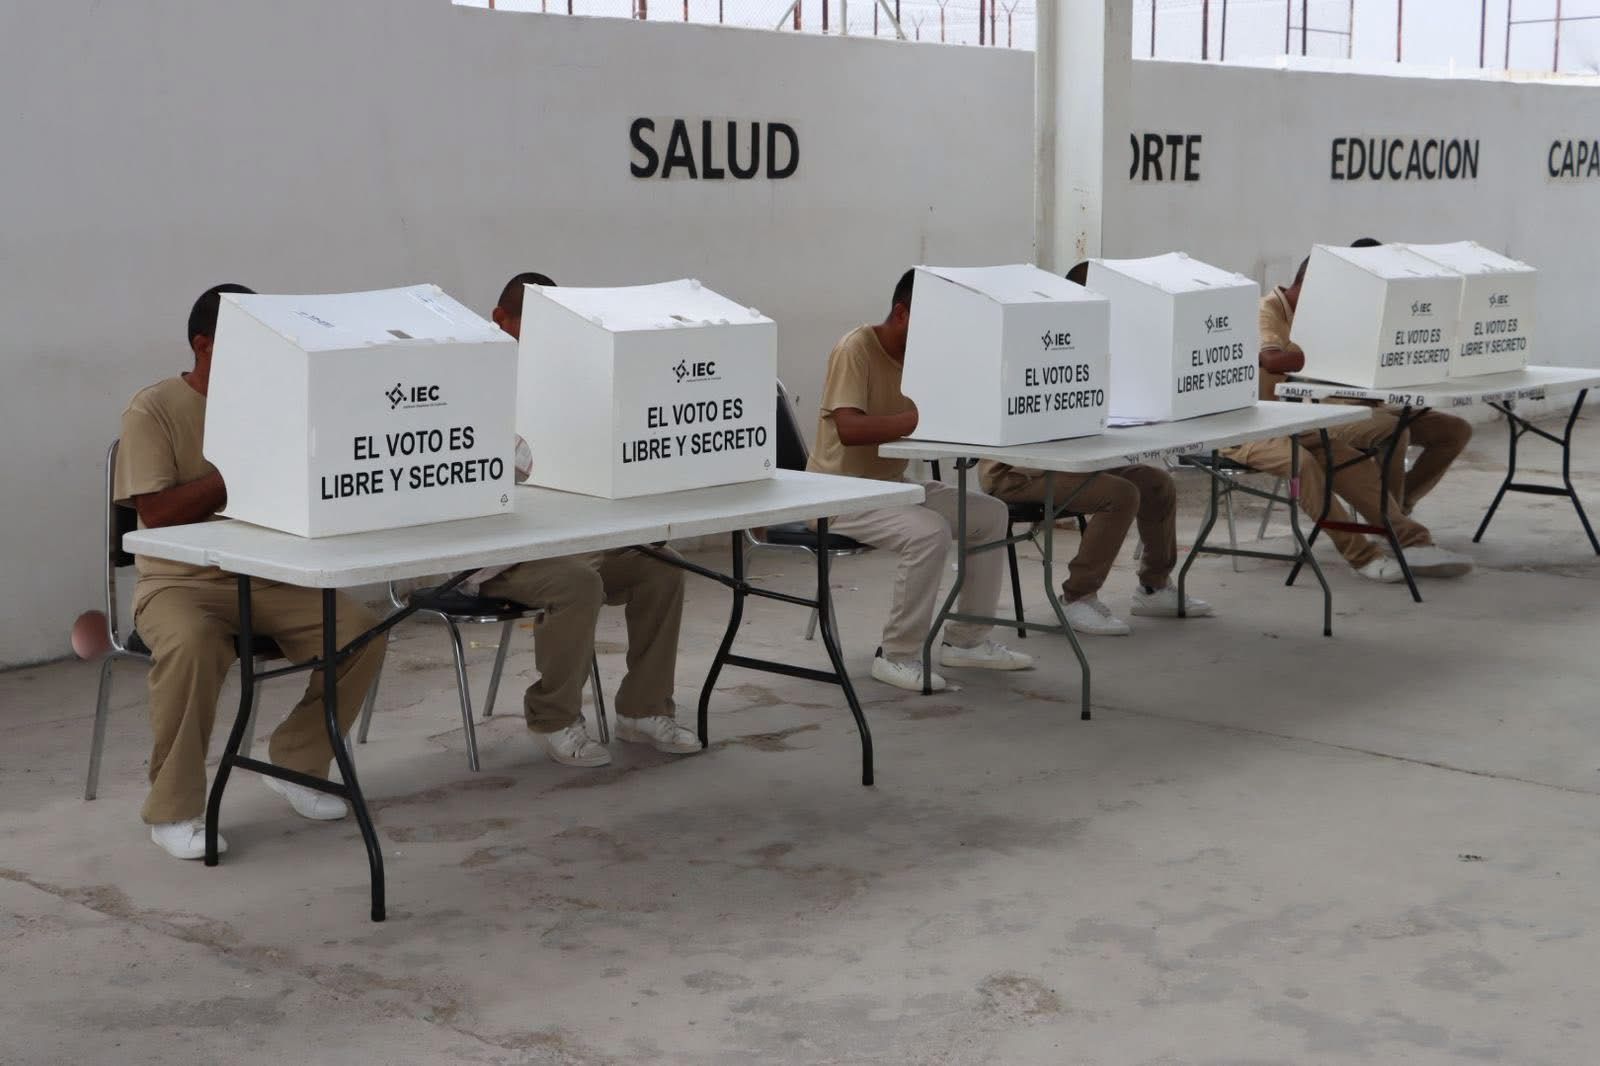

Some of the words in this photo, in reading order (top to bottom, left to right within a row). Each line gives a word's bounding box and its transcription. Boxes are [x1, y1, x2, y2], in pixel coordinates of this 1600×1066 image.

[629, 117, 800, 180] SALUD
[1331, 137, 1480, 180] EDUCACION
[1548, 140, 1600, 178] CAPA
[1420, 303, 1432, 313] IEC
[1497, 295, 1509, 304] IEC
[1215, 316, 1228, 329] IEC
[1474, 322, 1484, 336] EL
[1485, 320, 1506, 335] VOTO
[1508, 318, 1518, 333] ES
[1055, 333, 1071, 346] IEC
[1395, 331, 1405, 345] EL
[1408, 329, 1429, 344] VOTO
[1430, 328, 1441, 343] ES
[1460, 341, 1483, 357] LIBRE
[1485, 341, 1490, 354] Y
[1491, 337, 1526, 354] SECRETO
[1192, 350, 1204, 367] EL
[1206, 345, 1230, 364] VOTO
[1232, 342, 1243, 360] ES
[1381, 351, 1404, 367] LIBRE
[1406, 351, 1412, 364] Y
[1413, 348, 1449, 365] SECRETO
[692, 361, 716, 377] IEC
[1025, 367, 1040, 387] EL
[1042, 365, 1073, 385] VOTO
[1076, 364, 1089, 382] ES
[1177, 373, 1205, 393] LIBRE
[1207, 372, 1213, 388] Y
[1215, 364, 1255, 387] SECRETO
[410, 385, 440, 402] IEC
[1008, 395, 1041, 415] LIBRE
[1044, 393, 1052, 411] Y
[1054, 389, 1104, 411] SECRETO
[1388, 393, 1412, 406] DIAZ
[648, 406, 668, 428] EL
[673, 400, 718, 425] VOTO
[723, 398, 743, 420] ES
[353, 436, 380, 460] EL
[386, 429, 443, 457] VOTO
[450, 426, 475, 451] ES
[623, 437, 671, 464] LIBRE
[676, 435, 687, 457] Y
[691, 426, 767, 455] SECRETO
[321, 470, 384, 500] LIBRE
[390, 467, 403, 491] Y
[409, 457, 504, 490] SECRETO
